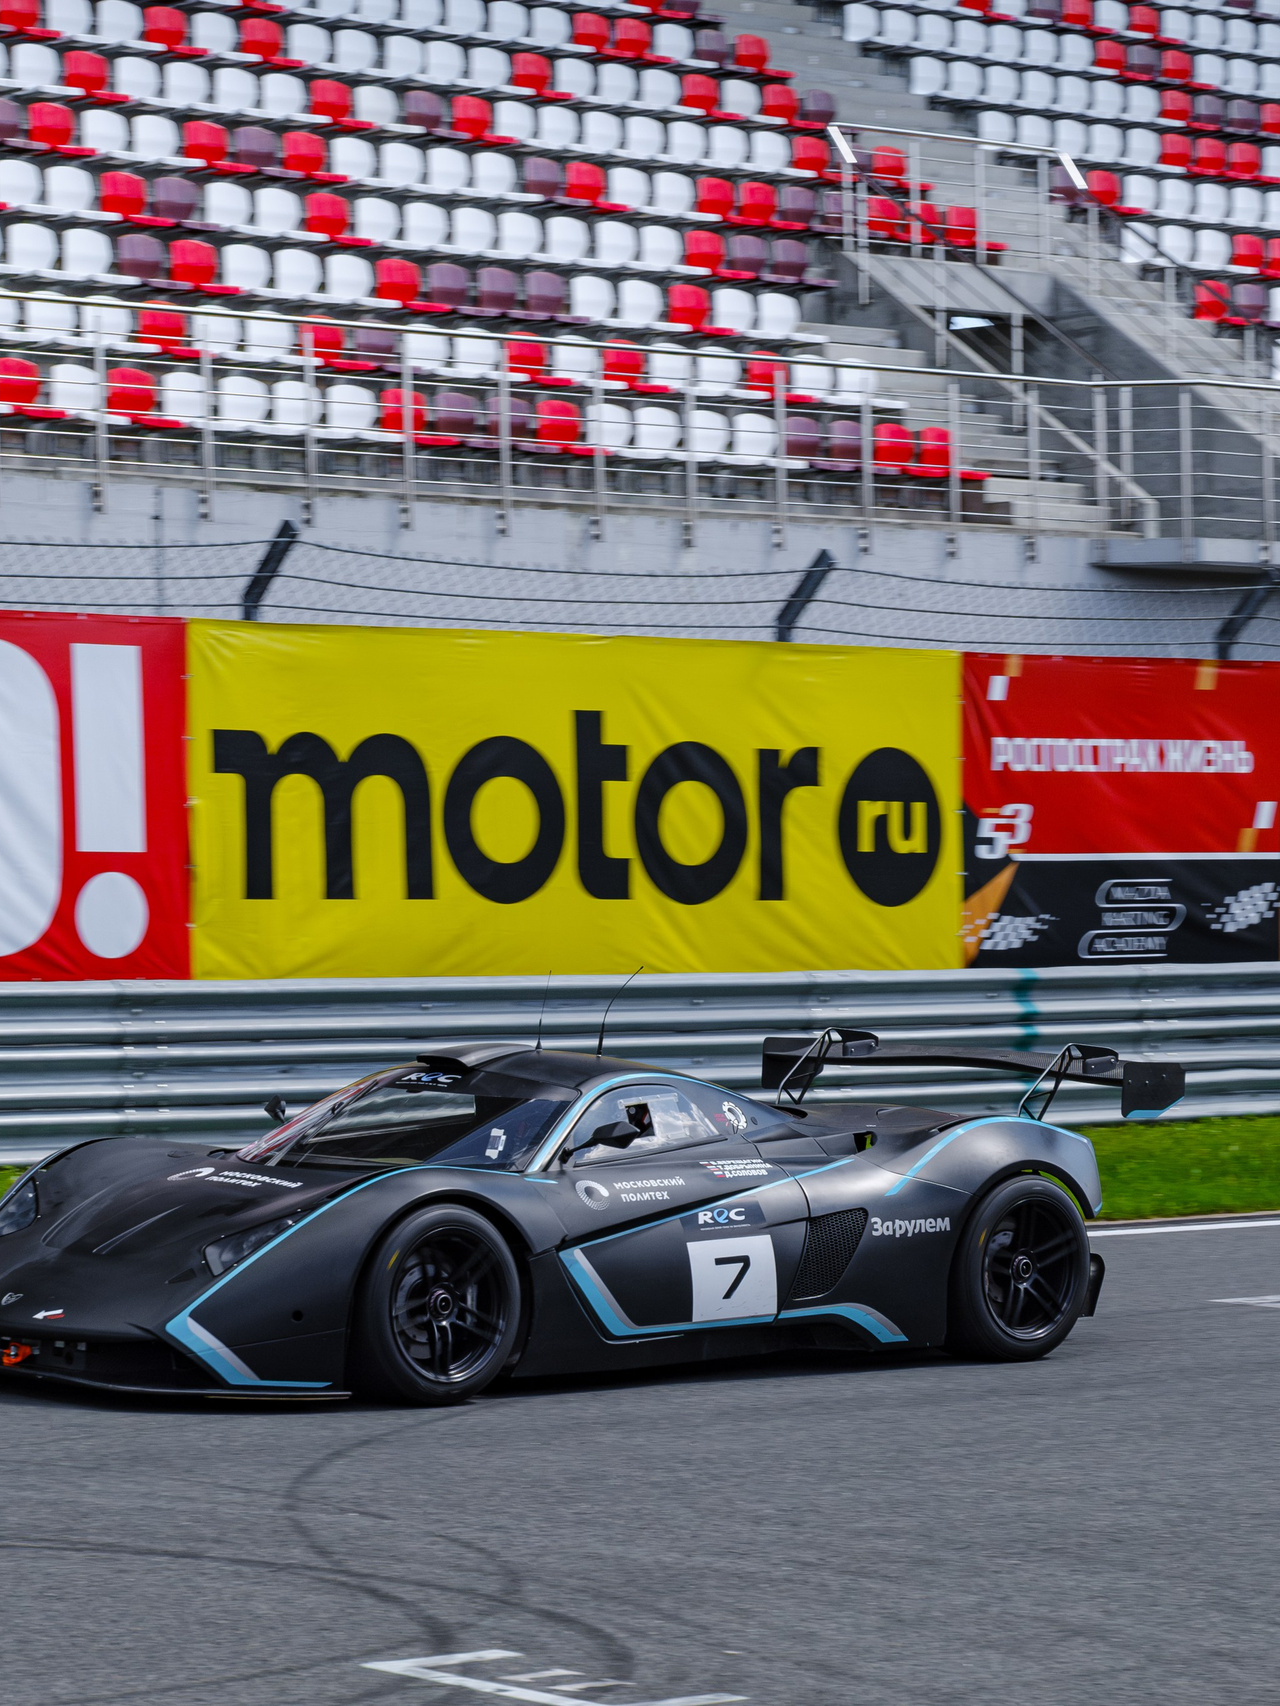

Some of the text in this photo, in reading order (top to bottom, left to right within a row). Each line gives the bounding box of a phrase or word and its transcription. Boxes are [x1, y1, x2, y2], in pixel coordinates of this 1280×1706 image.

[211, 709, 928, 905] motor ru
[714, 1254, 752, 1300] 7
